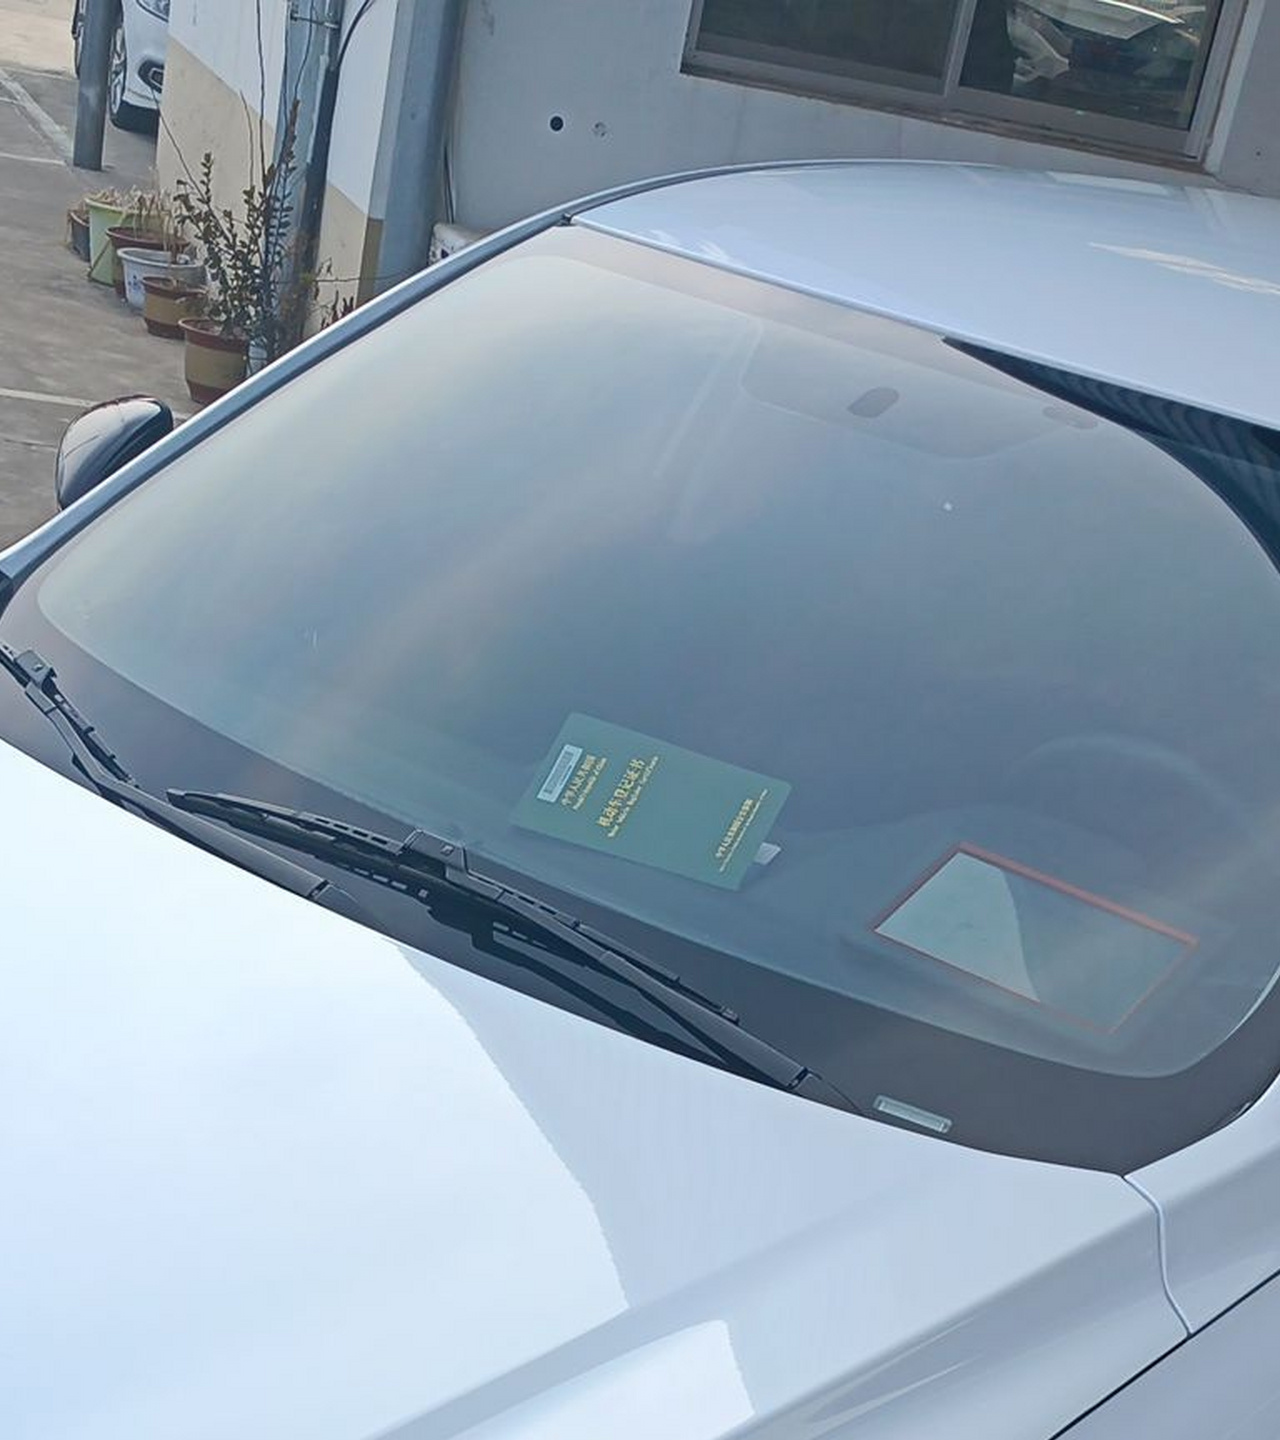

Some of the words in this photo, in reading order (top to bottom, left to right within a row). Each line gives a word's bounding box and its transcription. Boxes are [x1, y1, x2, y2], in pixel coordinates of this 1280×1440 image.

[596, 758, 646, 827] 机动车登记证书
